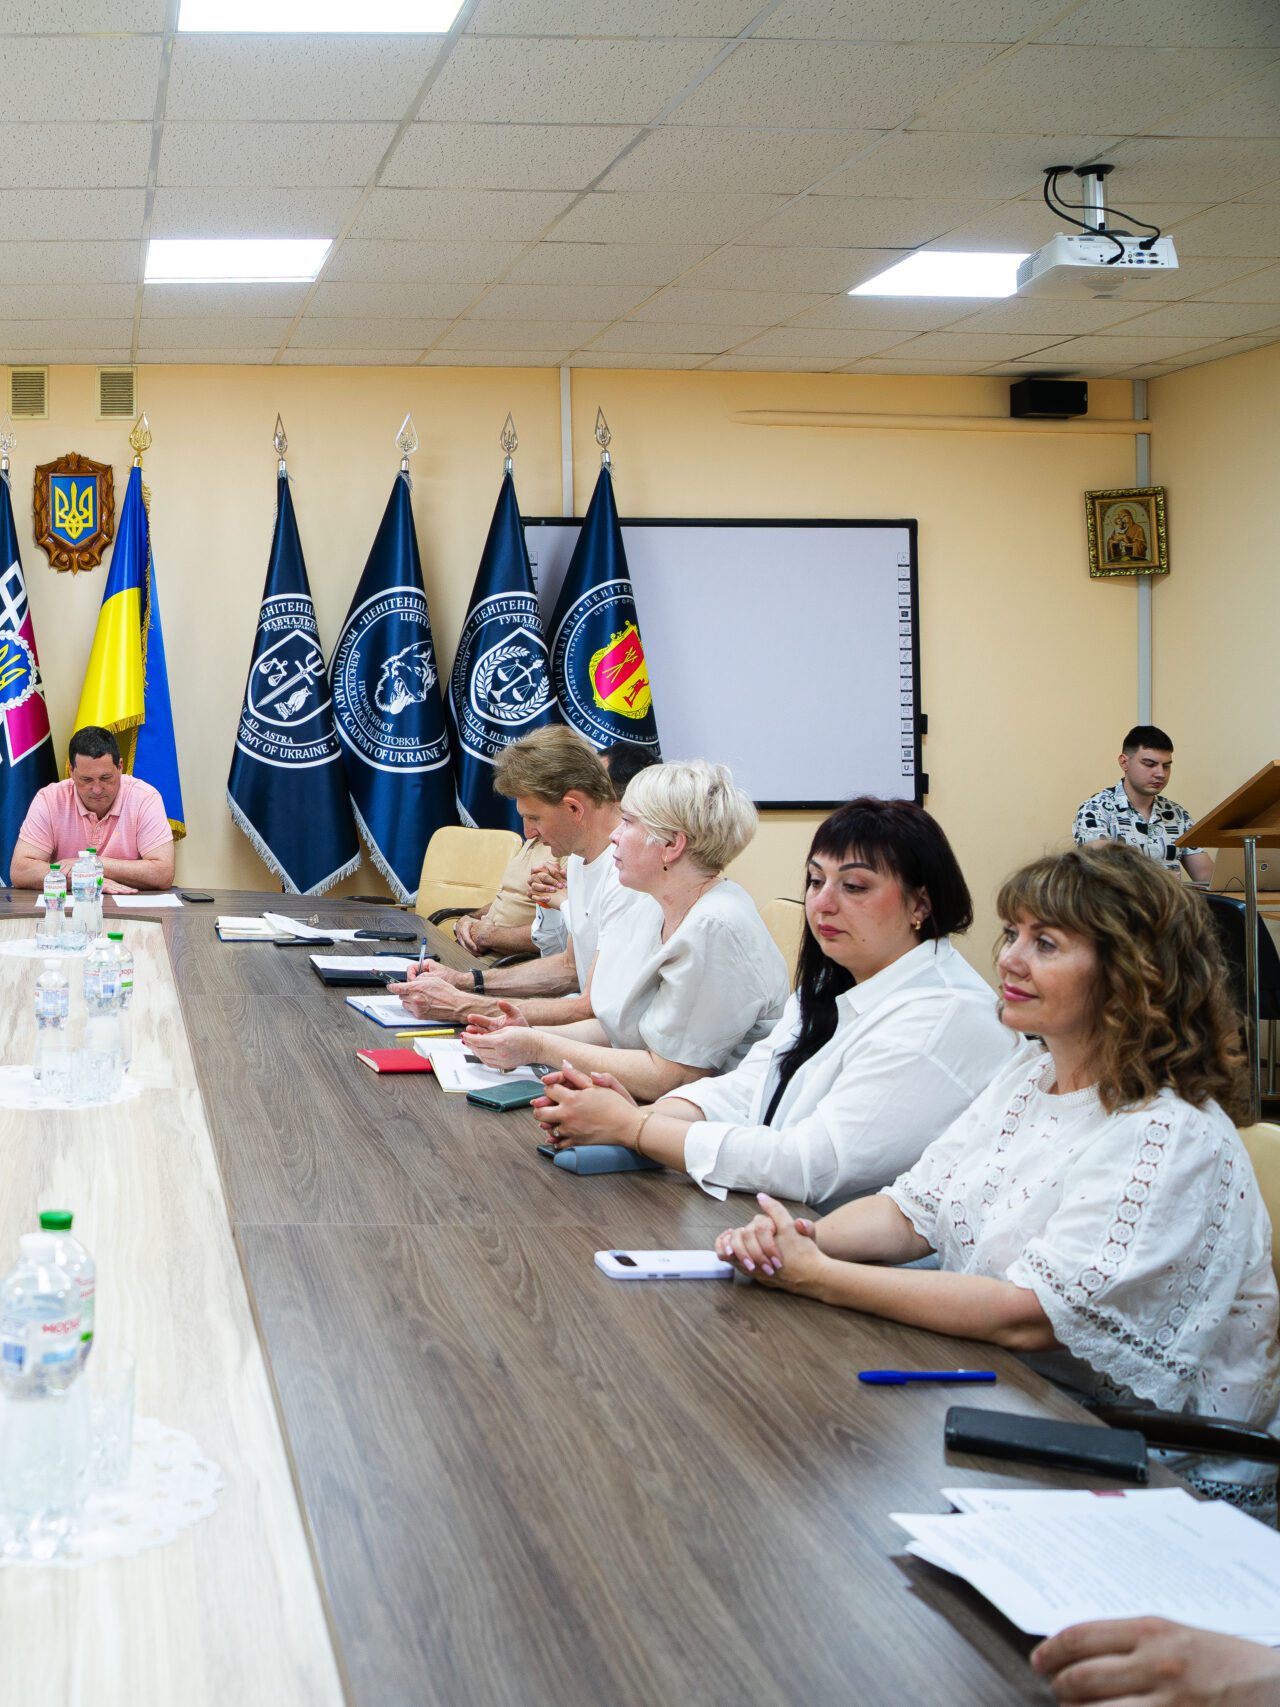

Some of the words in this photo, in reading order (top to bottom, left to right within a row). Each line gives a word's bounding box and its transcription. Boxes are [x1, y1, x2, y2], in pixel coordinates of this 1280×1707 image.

[334, 628, 358, 709] PENITENTIARY
[247, 718, 260, 729] AD
[263, 730, 294, 745] ASTRA
[340, 711, 376, 754] ACADEMY
[566, 706, 617, 746] ACADEMY
[262, 743, 278, 755] OF
[280, 743, 329, 759] UKRAINE
[374, 747, 388, 760] OF
[389, 747, 440, 763] UKRAINE
